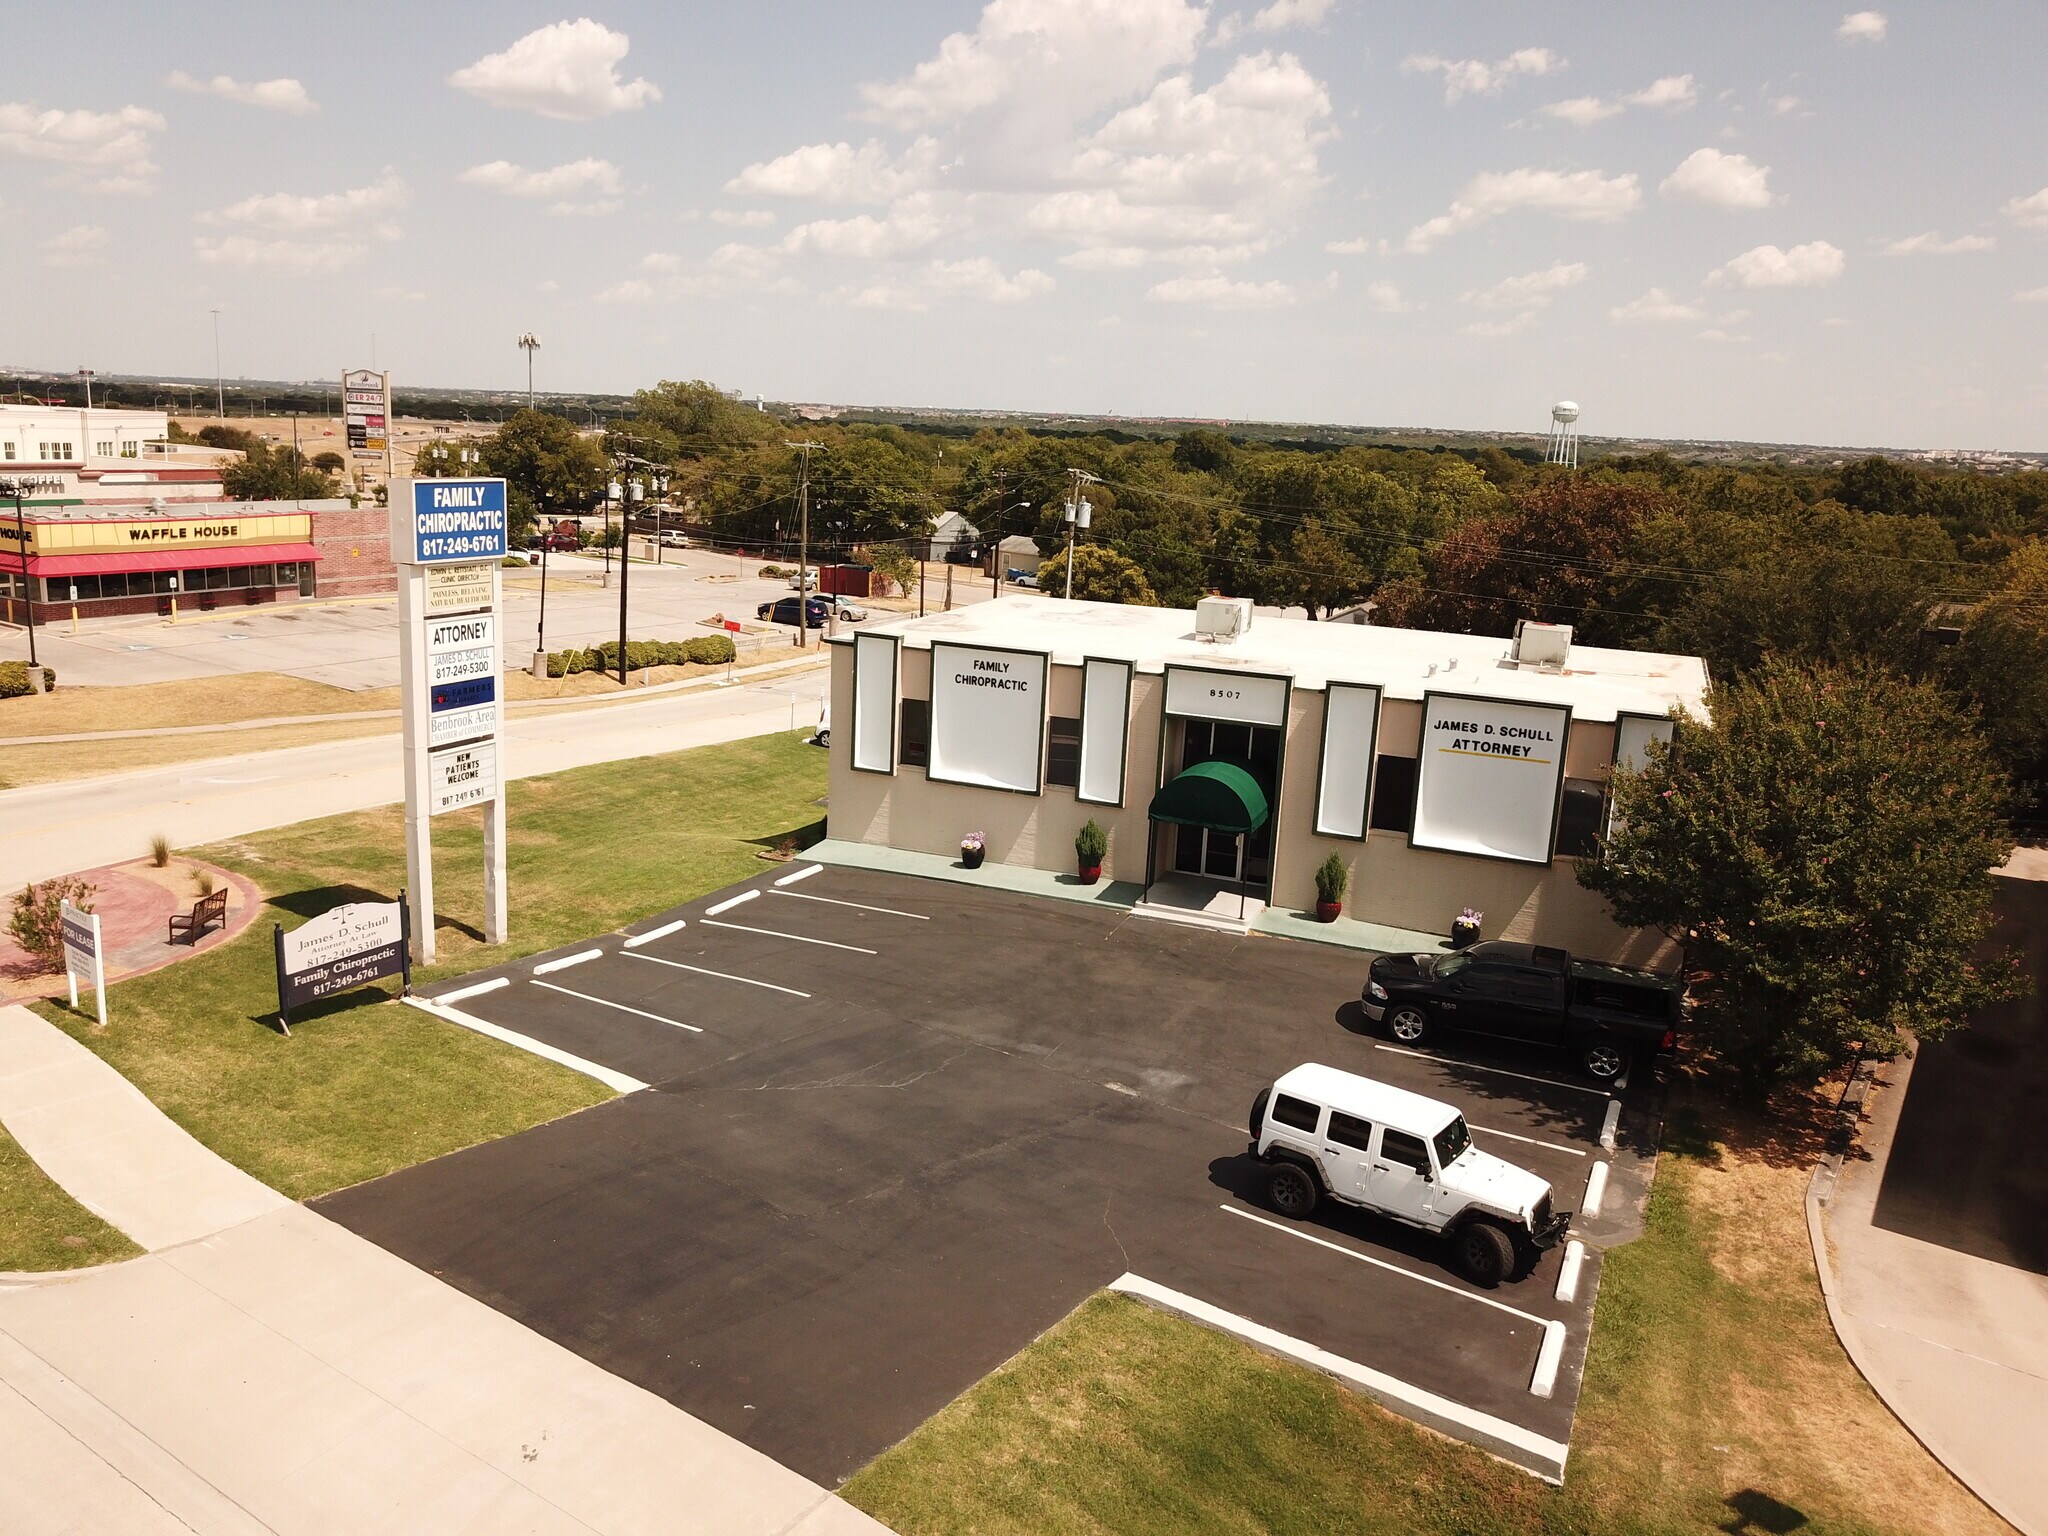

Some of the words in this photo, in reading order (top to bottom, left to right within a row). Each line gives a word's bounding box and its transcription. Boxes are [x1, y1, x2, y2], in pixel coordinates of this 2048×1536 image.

[434, 487, 485, 507] FAMILY
[417, 510, 503, 534] CHIROPRACTIC
[0, 527, 32, 542] HOUE
[129, 527, 187, 541] WAFFLE
[194, 525, 238, 539] HOUSE
[423, 535, 499, 556] 817-249-6761
[433, 621, 487, 645] ATTORNEY
[434, 653, 456, 666] JAMES
[457, 652, 465, 663] D.
[465, 648, 490, 662] SCHULL
[973, 660, 1010, 673] FAMILY
[436, 660, 489, 679] 817-249-5300
[452, 683, 492, 697] FARMERS
[955, 674, 1028, 691] CHIROPRACTIC
[1209, 688, 1241, 700] 8507
[431, 711, 473, 733] Benbrook
[475, 710, 495, 724] Area
[1433, 719, 1478, 733] JAMES
[1484, 724, 1496, 735] D.
[1499, 726, 1554, 742] SCHULL
[456, 752, 471, 763] NEW
[1452, 738, 1532, 758] ATTORNEY
[445, 759, 480, 775] PATIENTS
[447, 769, 479, 785] WELCOME
[63, 926, 75, 939] FOR
[76, 932, 94, 949] LEASE
[298, 933, 334, 953] James
[338, 927, 351, 938] D.
[354, 915, 389, 934] Schull
[311, 938, 347, 954] Attorney
[350, 934, 359, 943] At
[361, 930, 377, 940] Law
[307, 937, 382, 968] 817-249-5300
[294, 966, 330, 987] Family
[332, 946, 396, 974] Chiropractic
[313, 966, 379, 996] 817-249-6761
